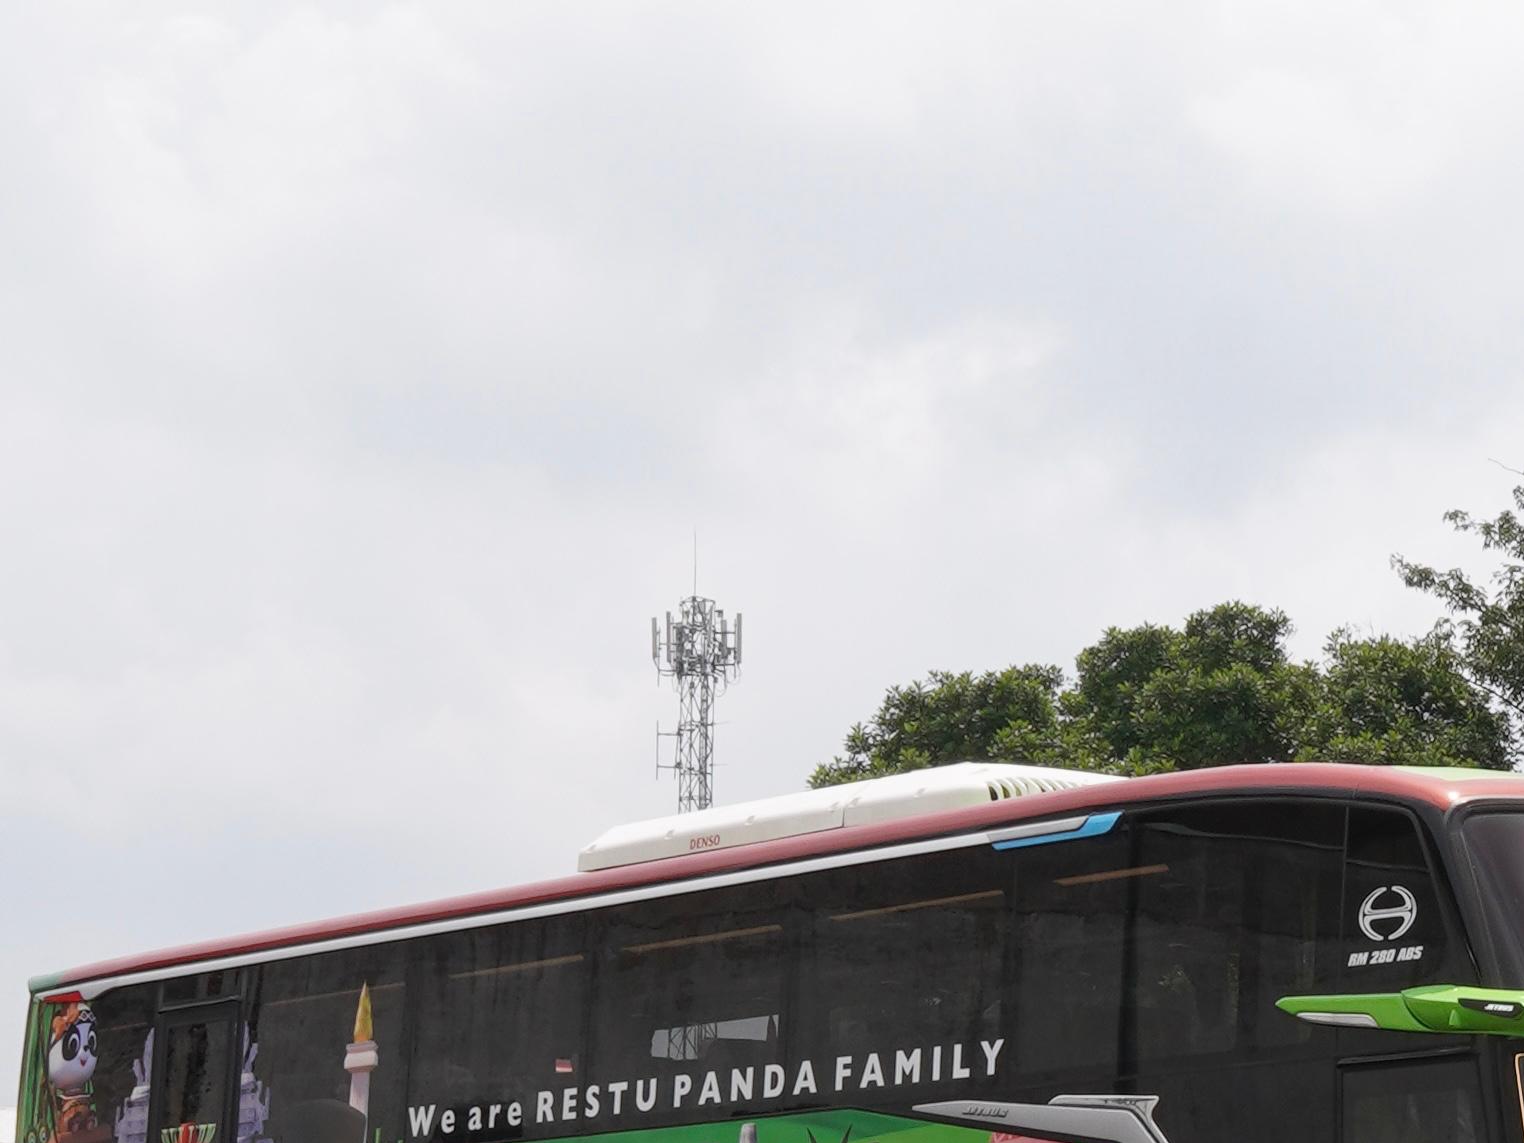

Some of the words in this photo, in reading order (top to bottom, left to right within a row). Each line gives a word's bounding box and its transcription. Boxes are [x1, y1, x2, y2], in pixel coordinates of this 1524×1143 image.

[689, 833, 721, 850] DENSO
[1369, 948, 1397, 965] 280
[1396, 945, 1424, 962] ABS
[407, 1104, 456, 1138] We
[467, 1100, 522, 1132] are
[535, 1078, 658, 1124] RESTU
[673, 1059, 818, 1109] PANDA
[834, 1038, 1005, 1092] FAMILY
